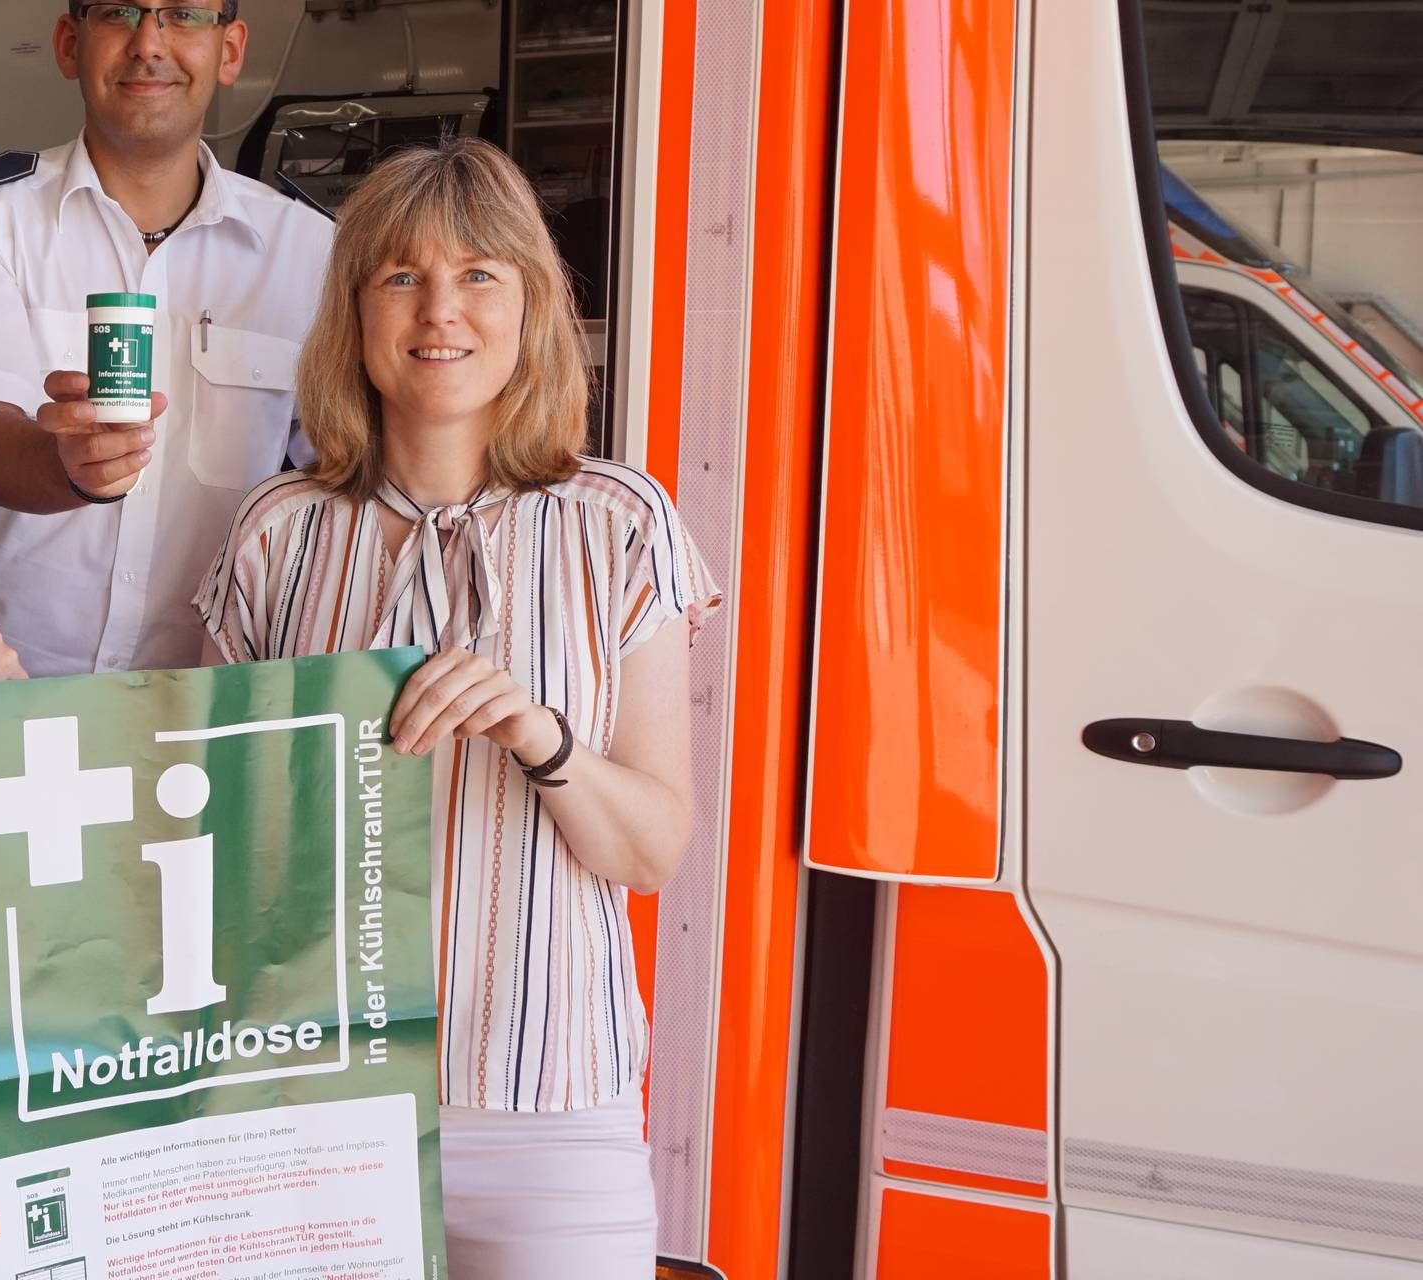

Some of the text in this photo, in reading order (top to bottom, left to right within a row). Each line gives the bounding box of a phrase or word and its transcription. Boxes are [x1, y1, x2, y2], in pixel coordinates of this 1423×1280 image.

[93, 325, 111, 333] SOS
[97, 387, 147, 396] Lebensrettung
[98, 370, 147, 378] Informationen
[352, 717, 387, 1065] in der KühlschrankTÜR
[52, 1021, 323, 1093] Notfalldose
[100, 1127, 297, 1166] Alle wichtigen Informationen für (Ihre) Retter
[102, 1178, 128, 1189] Immer
[130, 1172, 151, 1183] mehr
[153, 1163, 195, 1178] Menschen
[196, 1158, 224, 1169] haben
[226, 1157, 237, 1165] zu
[239, 1154, 267, 1163] Hause
[268, 1149, 292, 1159] einen
[327, 1143, 344, 1153] und
[103, 1202, 119, 1212] Nur
[122, 1199, 133, 1208] ist
[135, 1197, 146, 1205] es
[147, 1193, 160, 1202] für
[161, 1188, 187, 1199] Retter
[189, 1183, 215, 1193] meist
[216, 1176, 265, 1190] unmöglich
[343, 1165, 357, 1173] wo
[359, 1161, 384, 1171] diese
[183, 1173, 201, 1183] eine
[104, 1180, 320, 1223] Notfalldaten in der Wohnung aufbewahrt werden.
[106, 1210, 254, 1245] Die Lösung steht im Kühlschrank.
[107, 1215, 376, 1268] Wichtige Informationen für die Lebensrettung kommen in die
[108, 1262, 157, 1279] Notfalldose
[159, 1256, 176, 1267] und
[177, 1249, 209, 1262] werden
[211, 1246, 220, 1255] in
[222, 1243, 237, 1253] die
[239, 1232, 315, 1250] KühlschrankTÜR
[157, 1269, 170, 1278] sie
[172, 1264, 195, 1275] einen
[197, 1258, 225, 1268] festen
[227, 1254, 242, 1263] Ort
[244, 1251, 262, 1262] und
[264, 1246, 297, 1259] können
[299, 1243, 308, 1252] in
[310, 1241, 339, 1253] jedem
[342, 1237, 383, 1249] Haushalt
[268, 1270, 282, 1279] der
[284, 1265, 328, 1276] Innenseite
[331, 1263, 345, 1272] der
[347, 1256, 404, 1270] Wohnungstür
